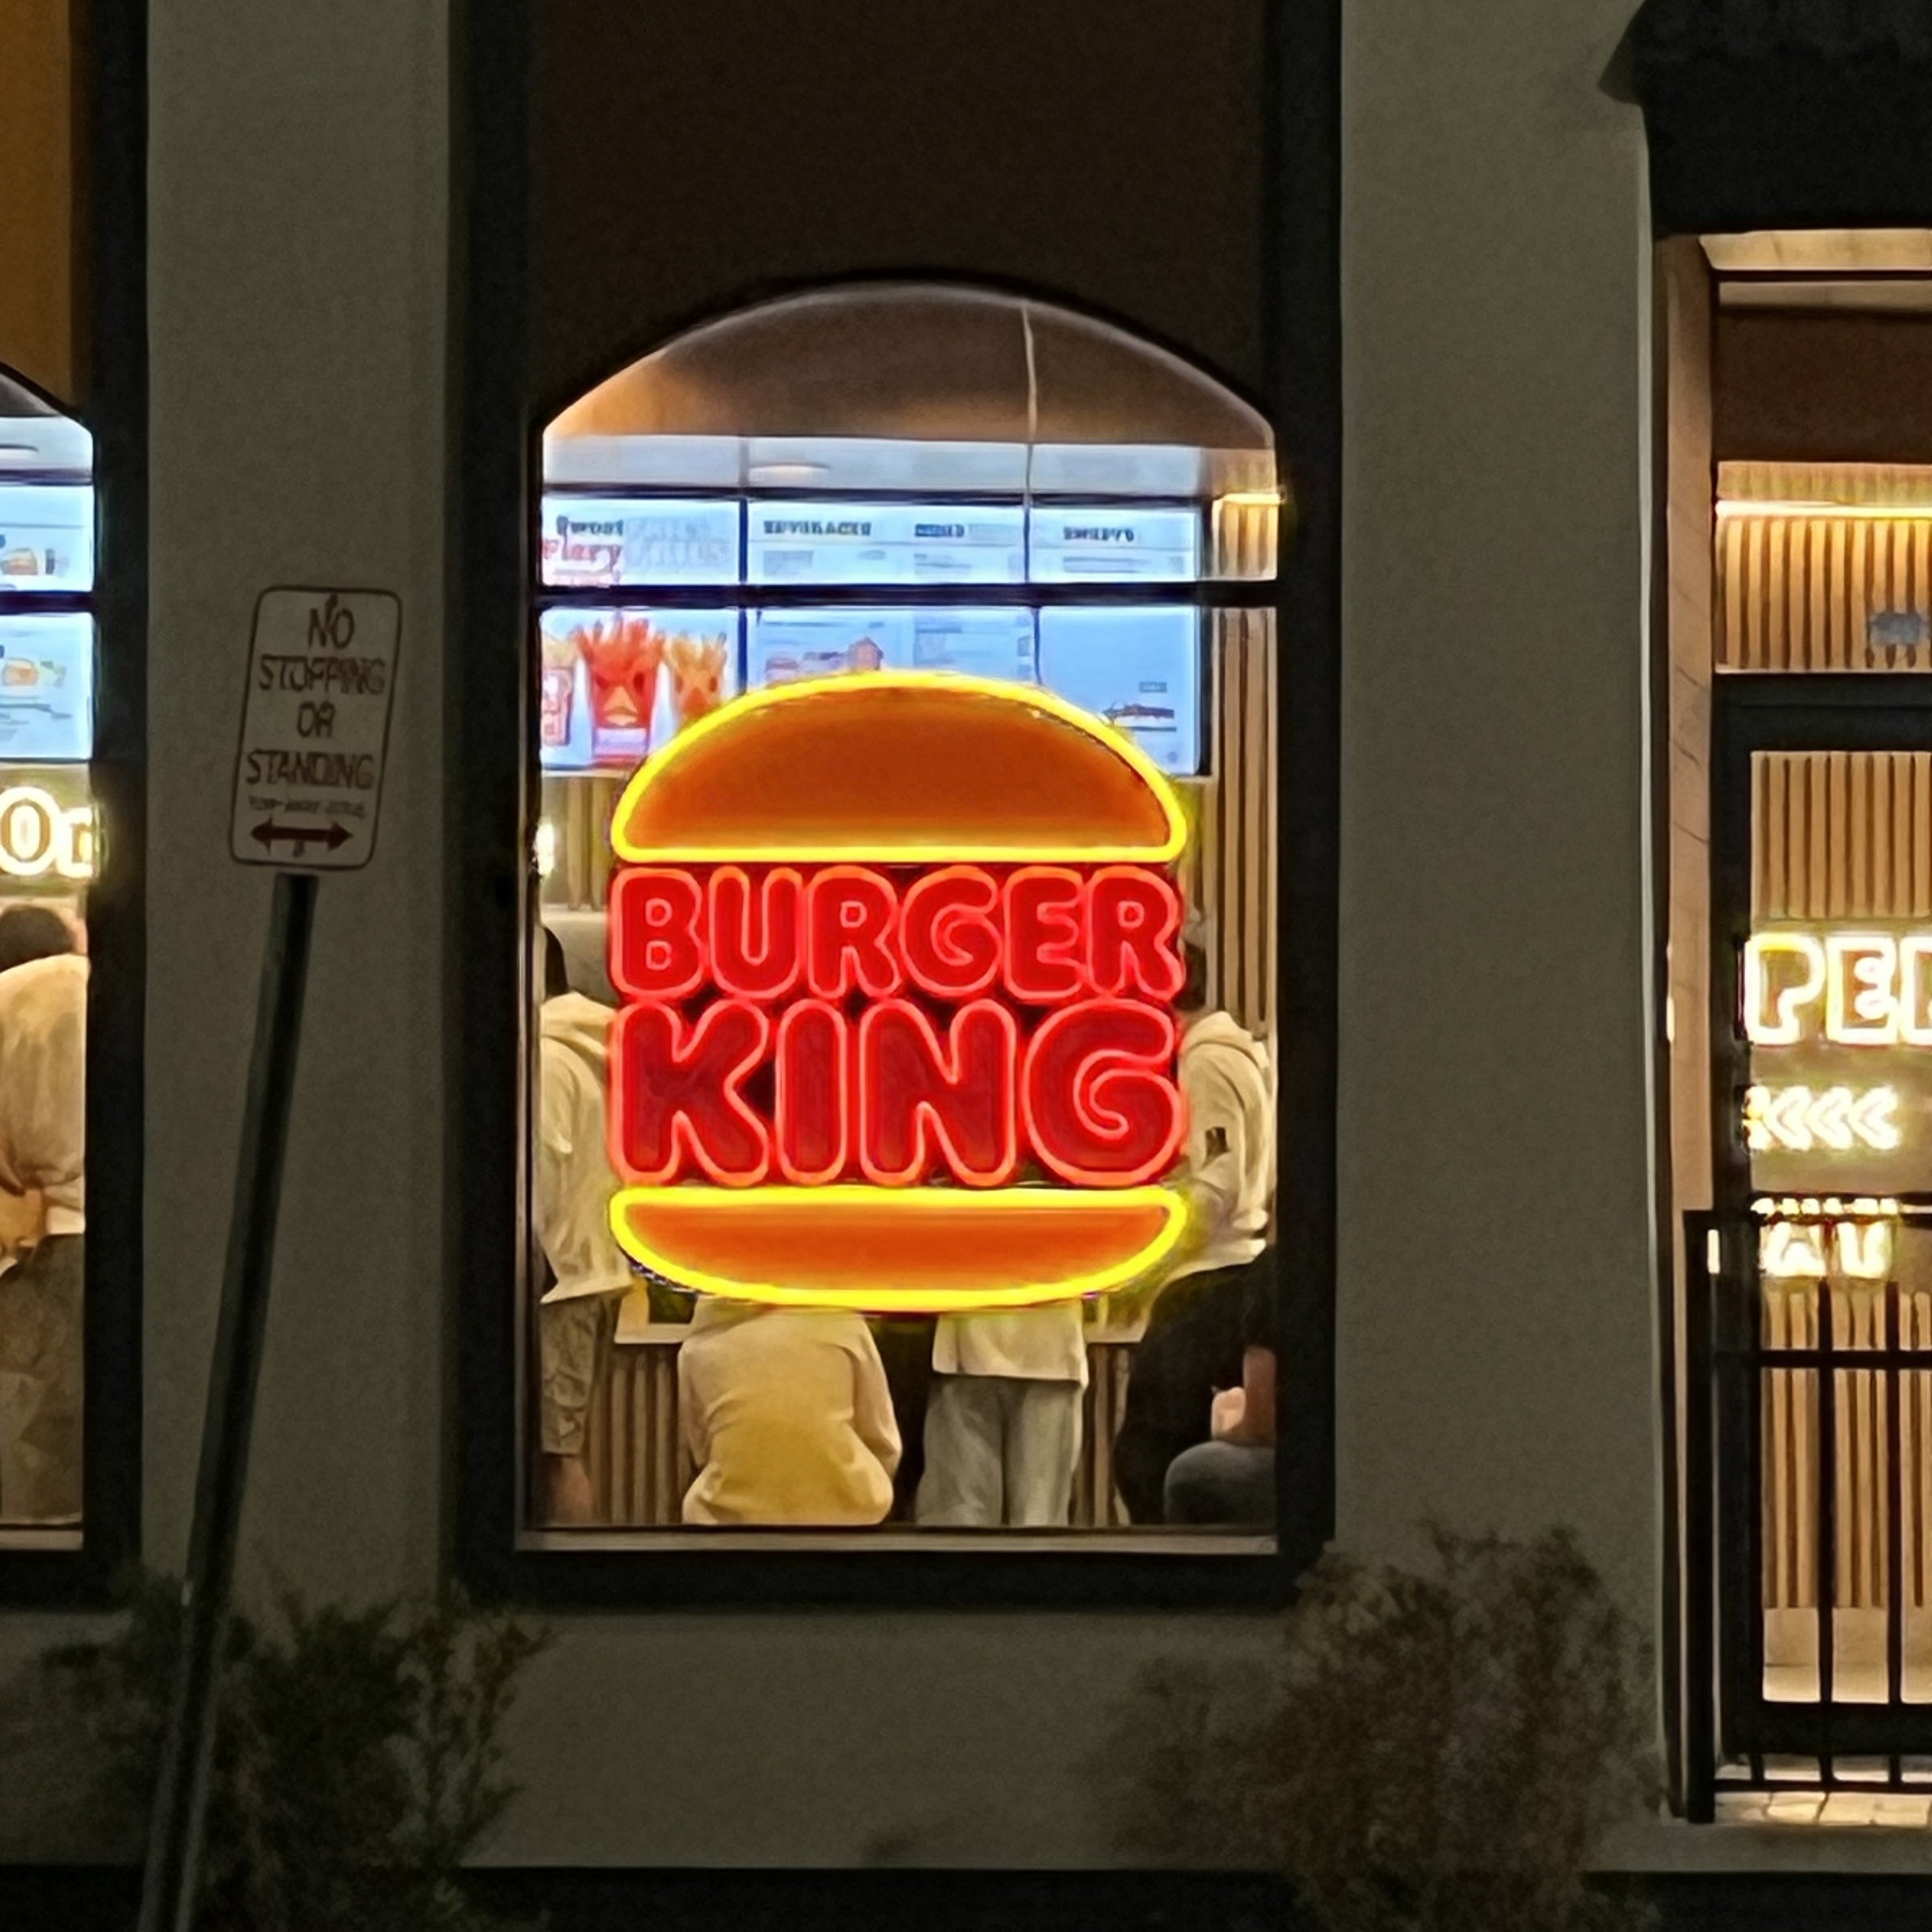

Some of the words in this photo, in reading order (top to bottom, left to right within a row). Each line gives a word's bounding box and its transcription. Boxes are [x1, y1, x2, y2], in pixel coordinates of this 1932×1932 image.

[309, 595, 355, 649] NO
[259, 654, 386, 695] STOPPING
[297, 700, 335, 738] OR
[247, 748, 374, 790] STANDING
[611, 865, 1184, 1002] BURGER
[611, 998, 1184, 1186] KING
